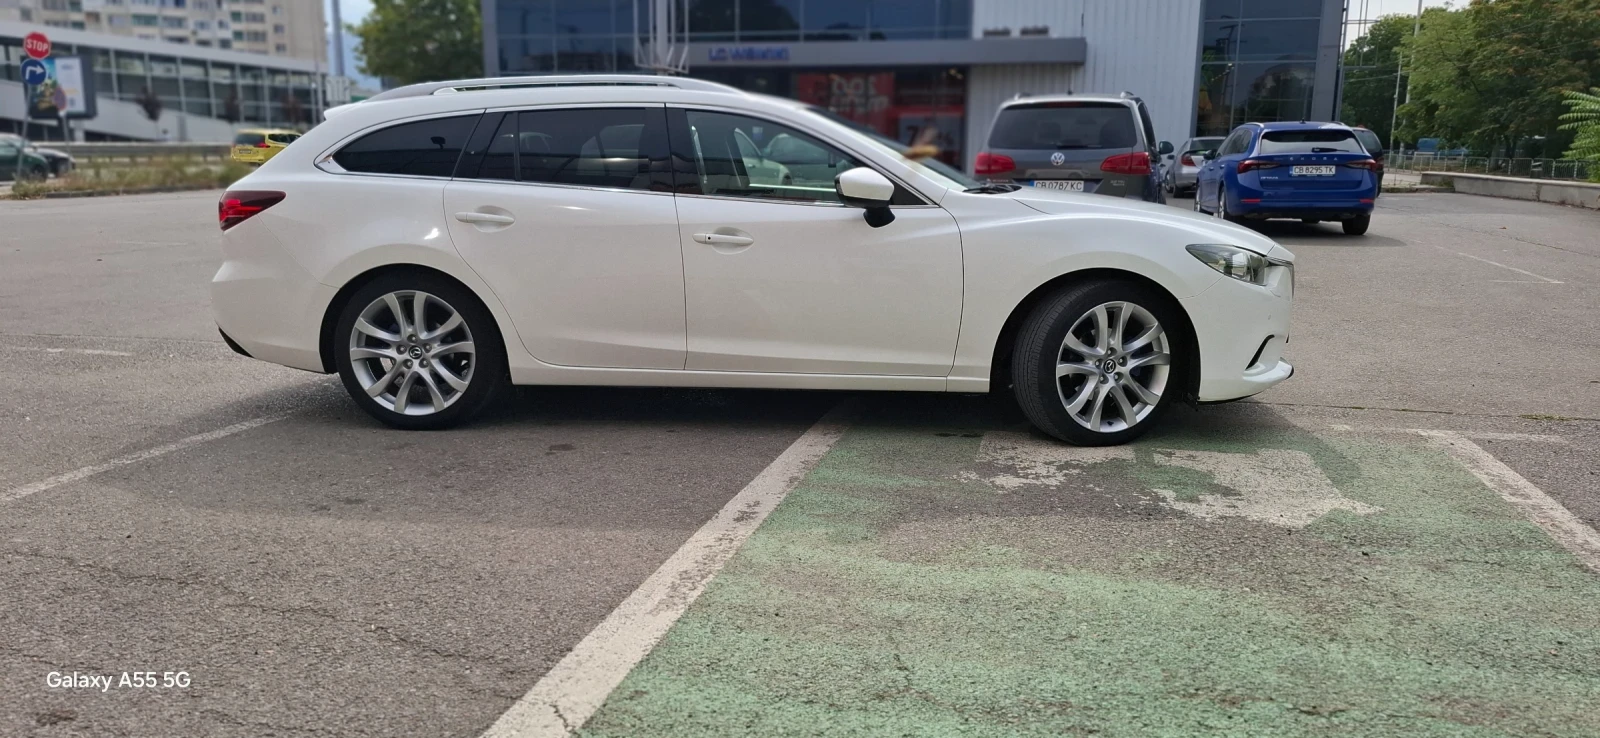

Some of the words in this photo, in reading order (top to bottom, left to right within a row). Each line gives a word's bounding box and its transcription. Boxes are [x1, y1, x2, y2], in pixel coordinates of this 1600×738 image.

[26, 38, 49, 52] STOP
[1293, 166, 1304, 174] CB
[1304, 166, 1323, 174] 8295
[1324, 166, 1334, 174] TK
[1048, 181, 1069, 190] 0787
[1070, 181, 1083, 191] KC
